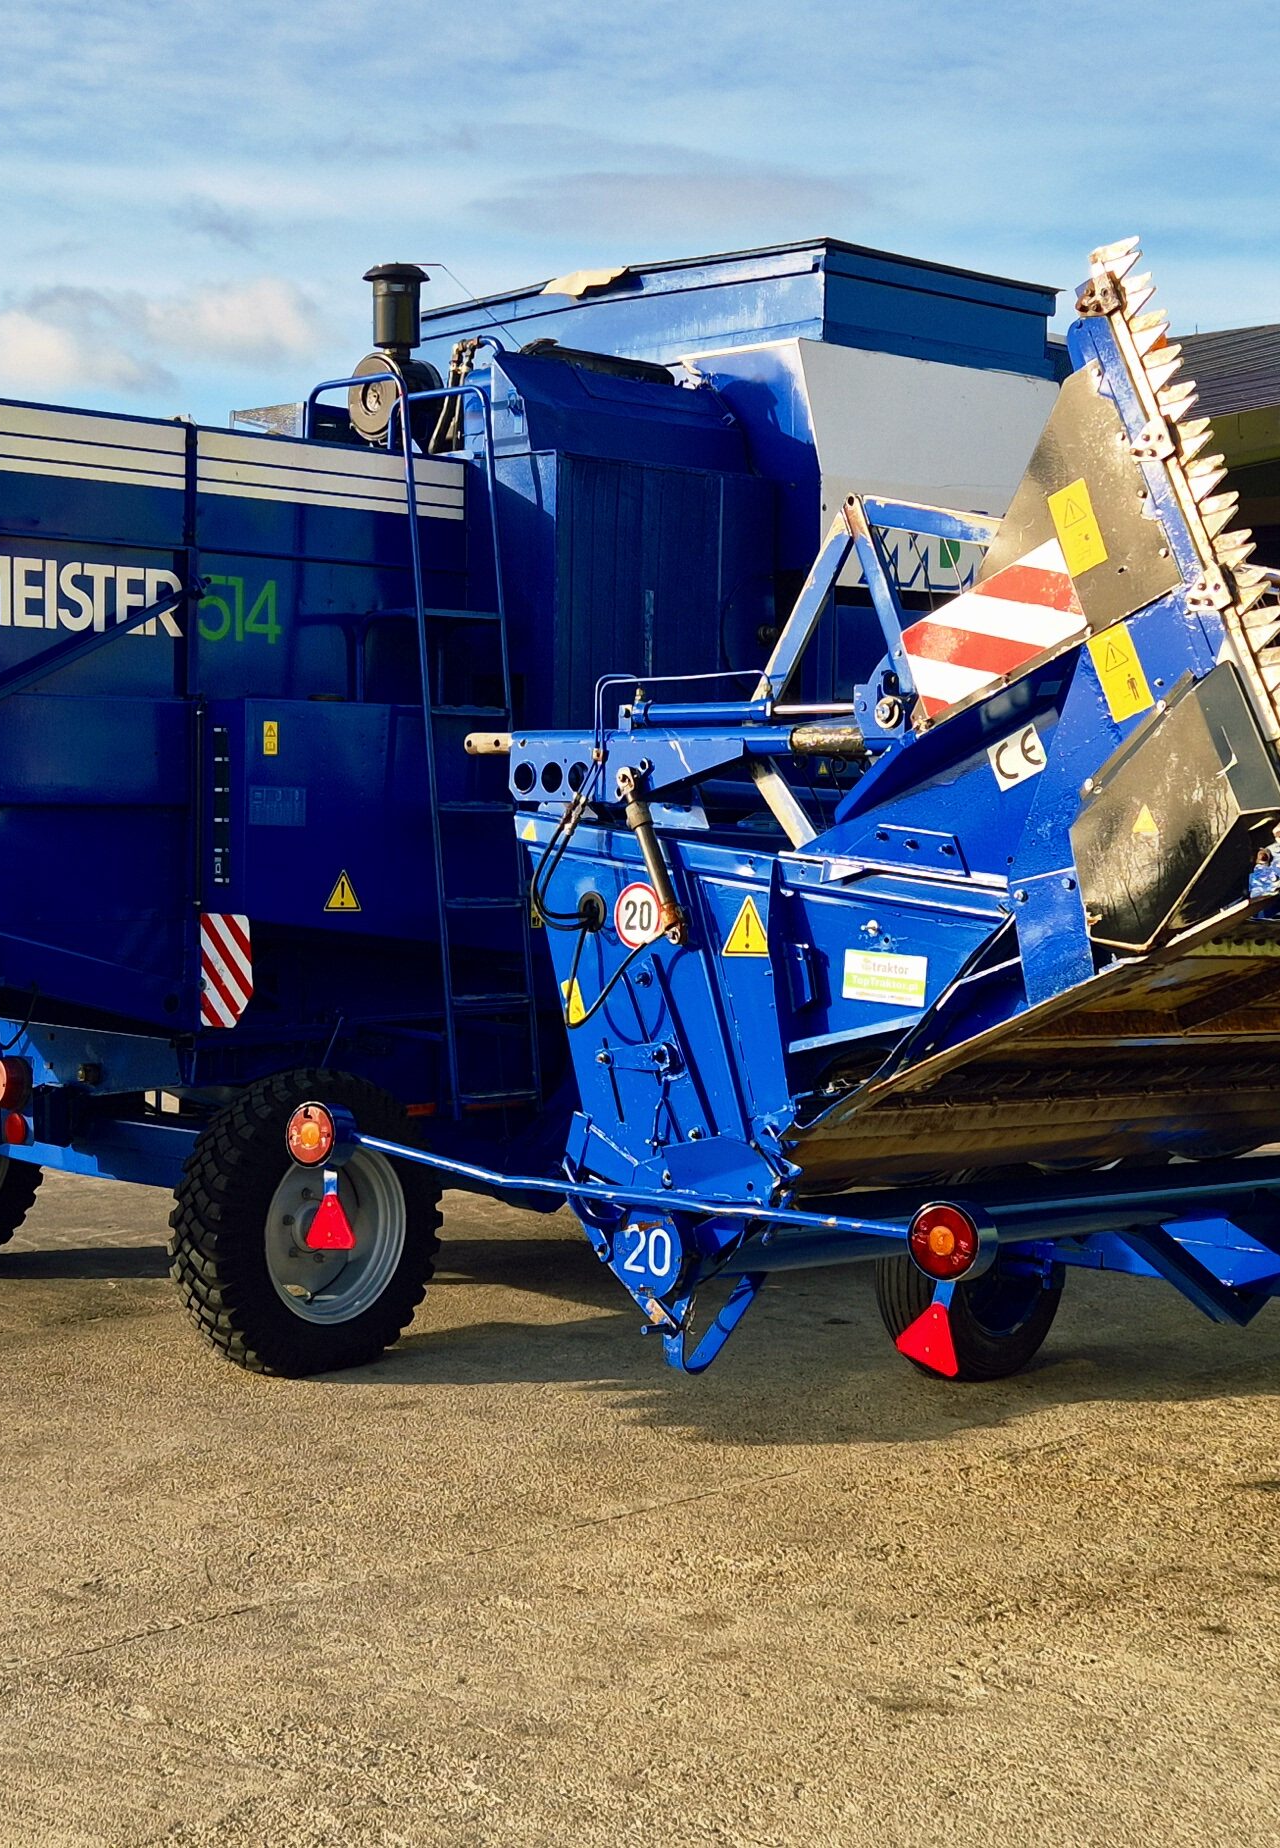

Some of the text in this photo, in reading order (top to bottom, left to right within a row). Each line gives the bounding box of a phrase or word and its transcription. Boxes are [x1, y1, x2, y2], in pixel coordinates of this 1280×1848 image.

[197, 574, 282, 644] 514
[995, 727, 1044, 779] CE
[624, 900, 652, 931] 20
[873, 961, 909, 975] traktor
[623, 1223, 671, 1277] 20
